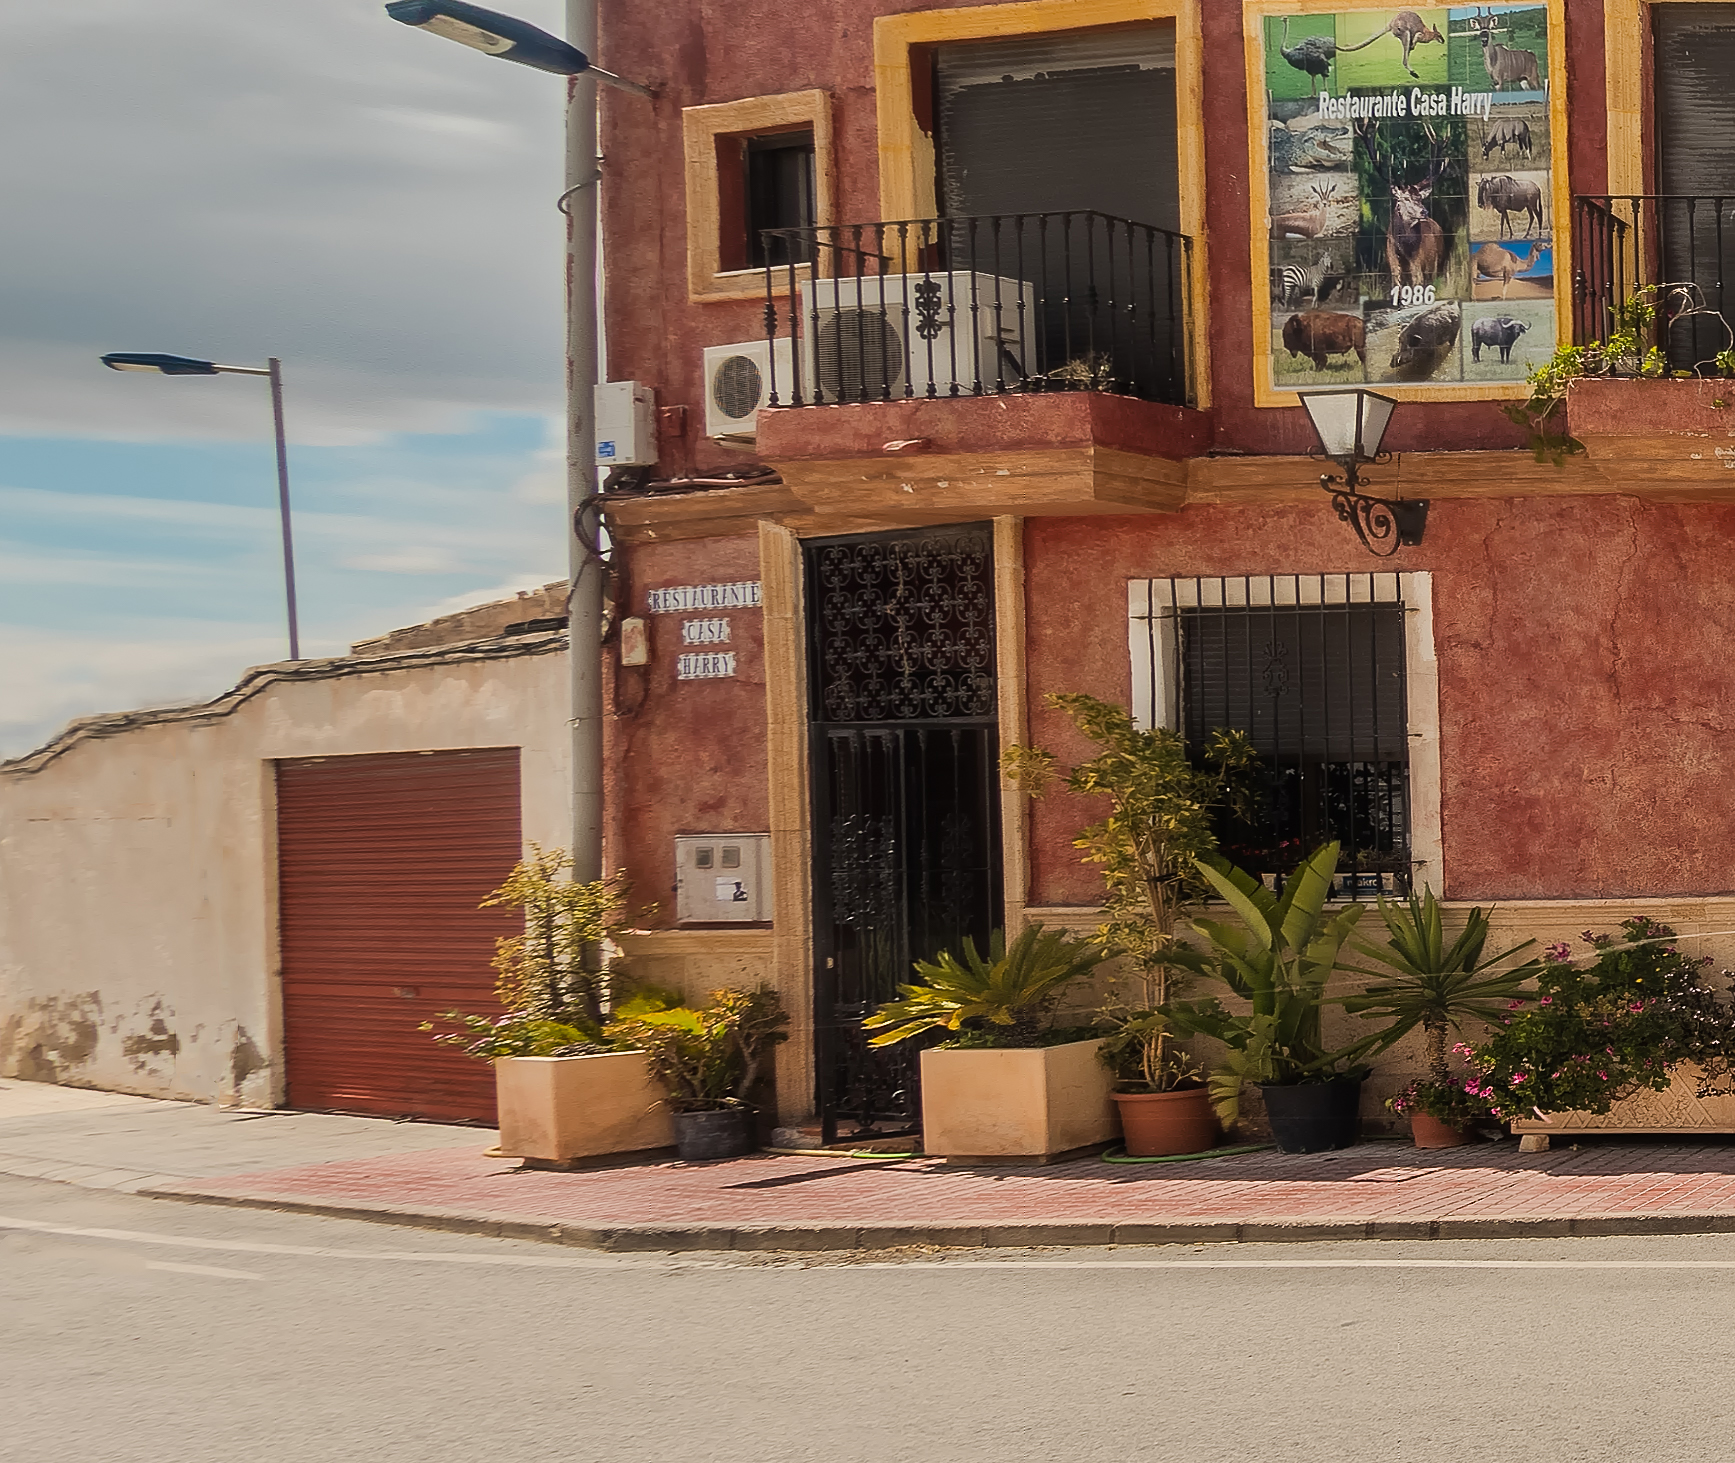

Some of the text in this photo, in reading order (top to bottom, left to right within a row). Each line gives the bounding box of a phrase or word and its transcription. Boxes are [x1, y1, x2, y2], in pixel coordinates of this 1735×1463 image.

[1319, 88, 1493, 121] Restaurante Casa Harry
[1390, 284, 1436, 308] 1986
[652, 586, 759, 609] RESTAURANTE
[688, 623, 726, 640] CASA
[683, 656, 729, 674] HARRY
